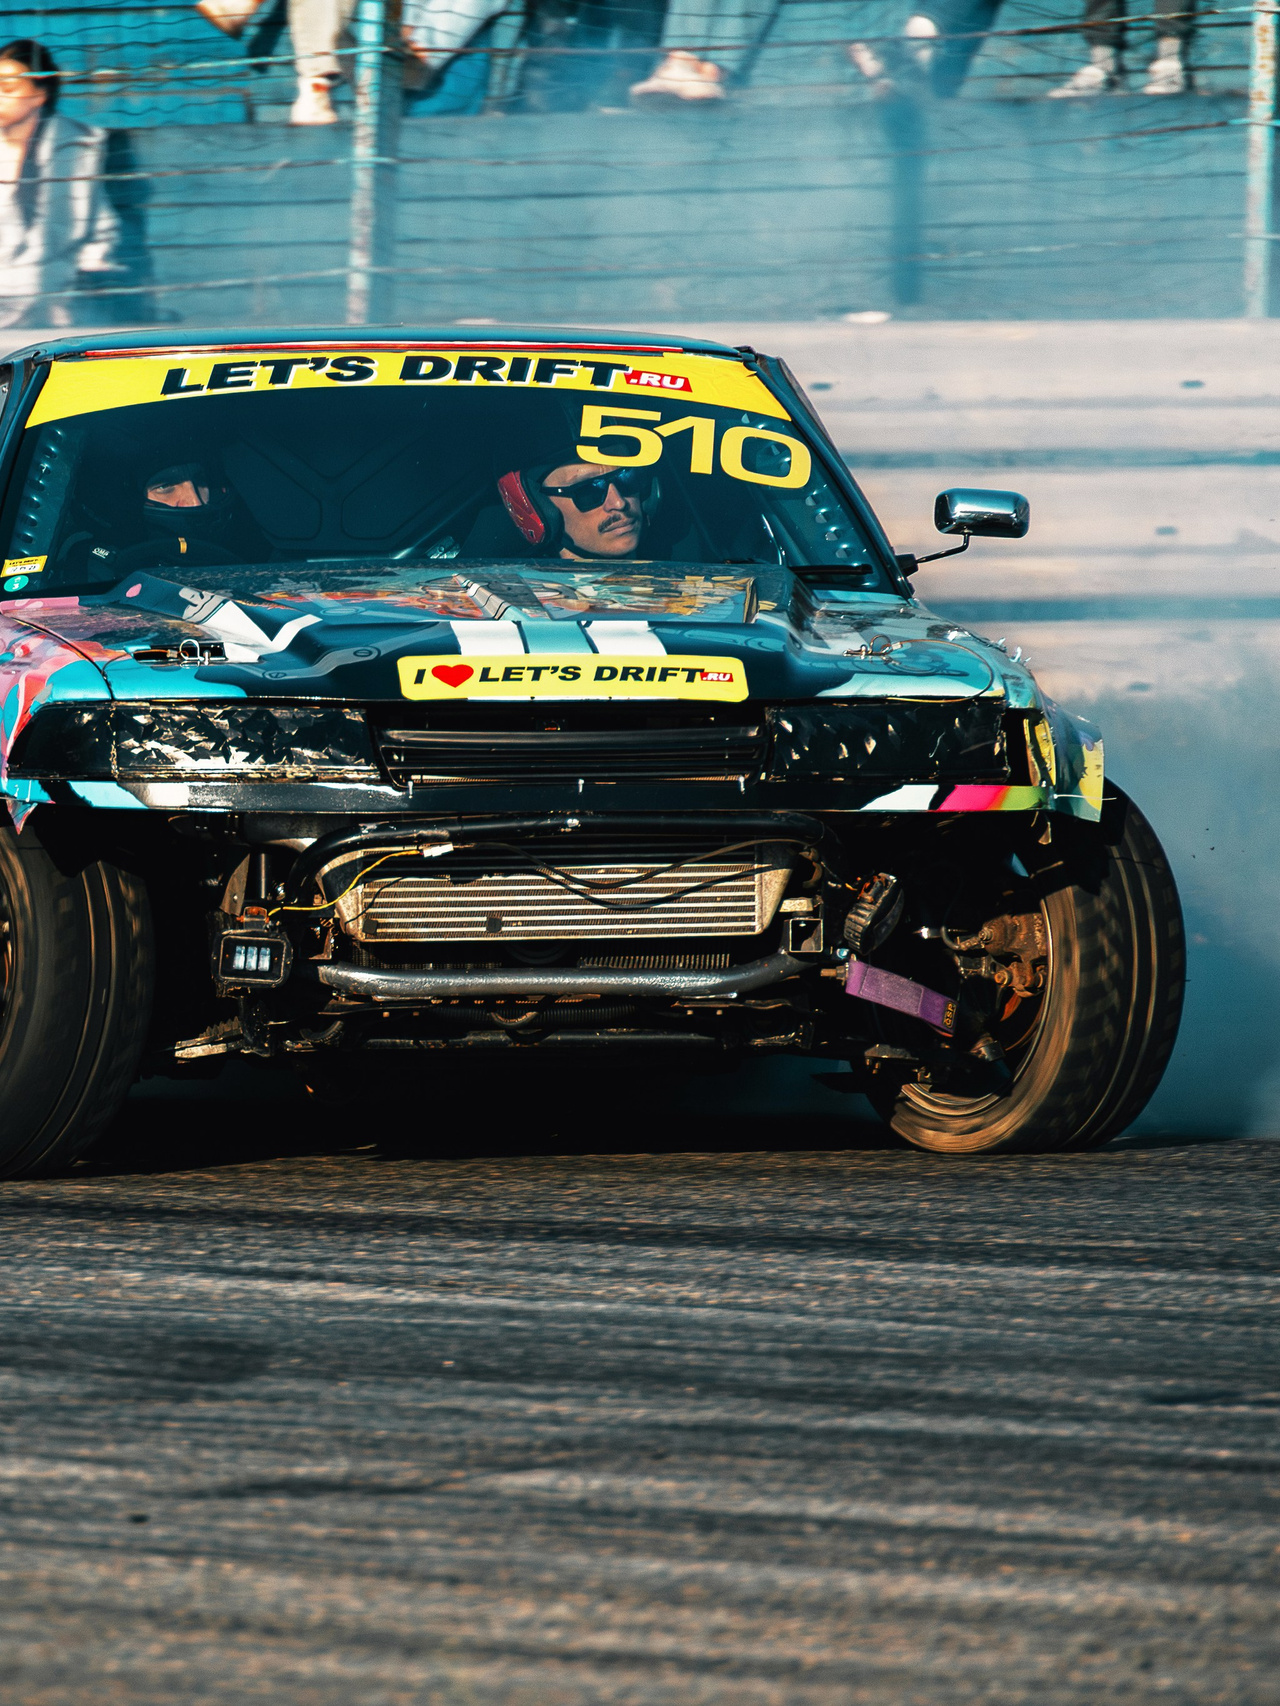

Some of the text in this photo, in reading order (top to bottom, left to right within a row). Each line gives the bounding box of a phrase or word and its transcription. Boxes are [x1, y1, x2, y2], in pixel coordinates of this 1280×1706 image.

[160, 355, 378, 396] LET'S
[576, 405, 812, 489] 510
[414, 668, 426, 684] I
[479, 666, 581, 682] LET'S
